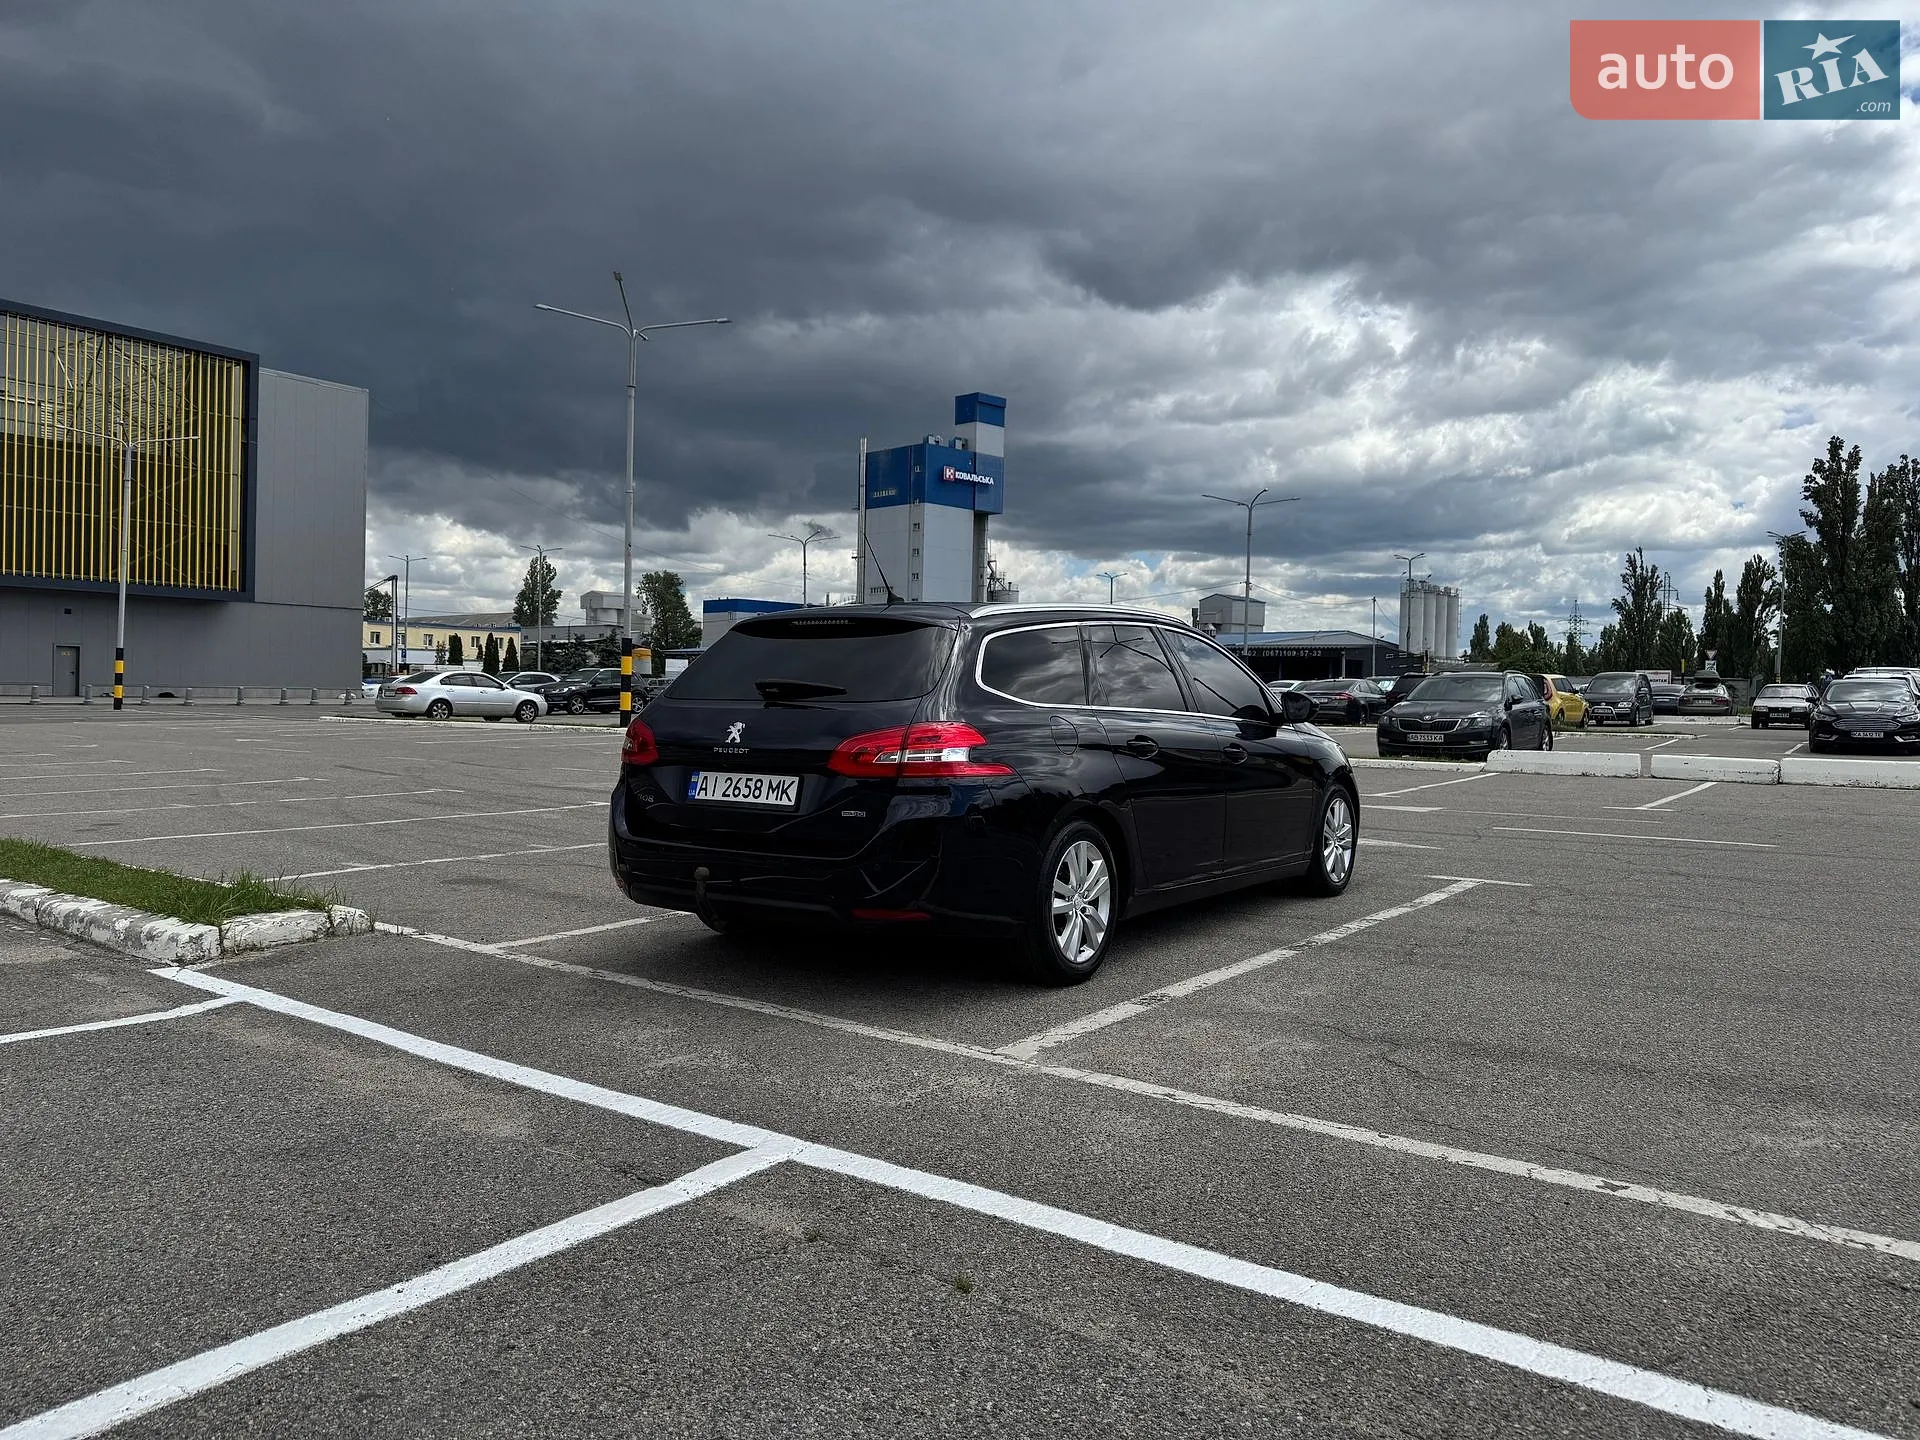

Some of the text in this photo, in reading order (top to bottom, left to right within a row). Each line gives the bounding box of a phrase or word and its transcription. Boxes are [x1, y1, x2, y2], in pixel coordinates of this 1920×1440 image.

[955, 470, 995, 485] КОВАЛЬСЬКА
[713, 746, 750, 755] PEUGEOT
[697, 775, 718, 797] AI
[721, 776, 764, 799] 2658
[765, 778, 797, 803] MK
